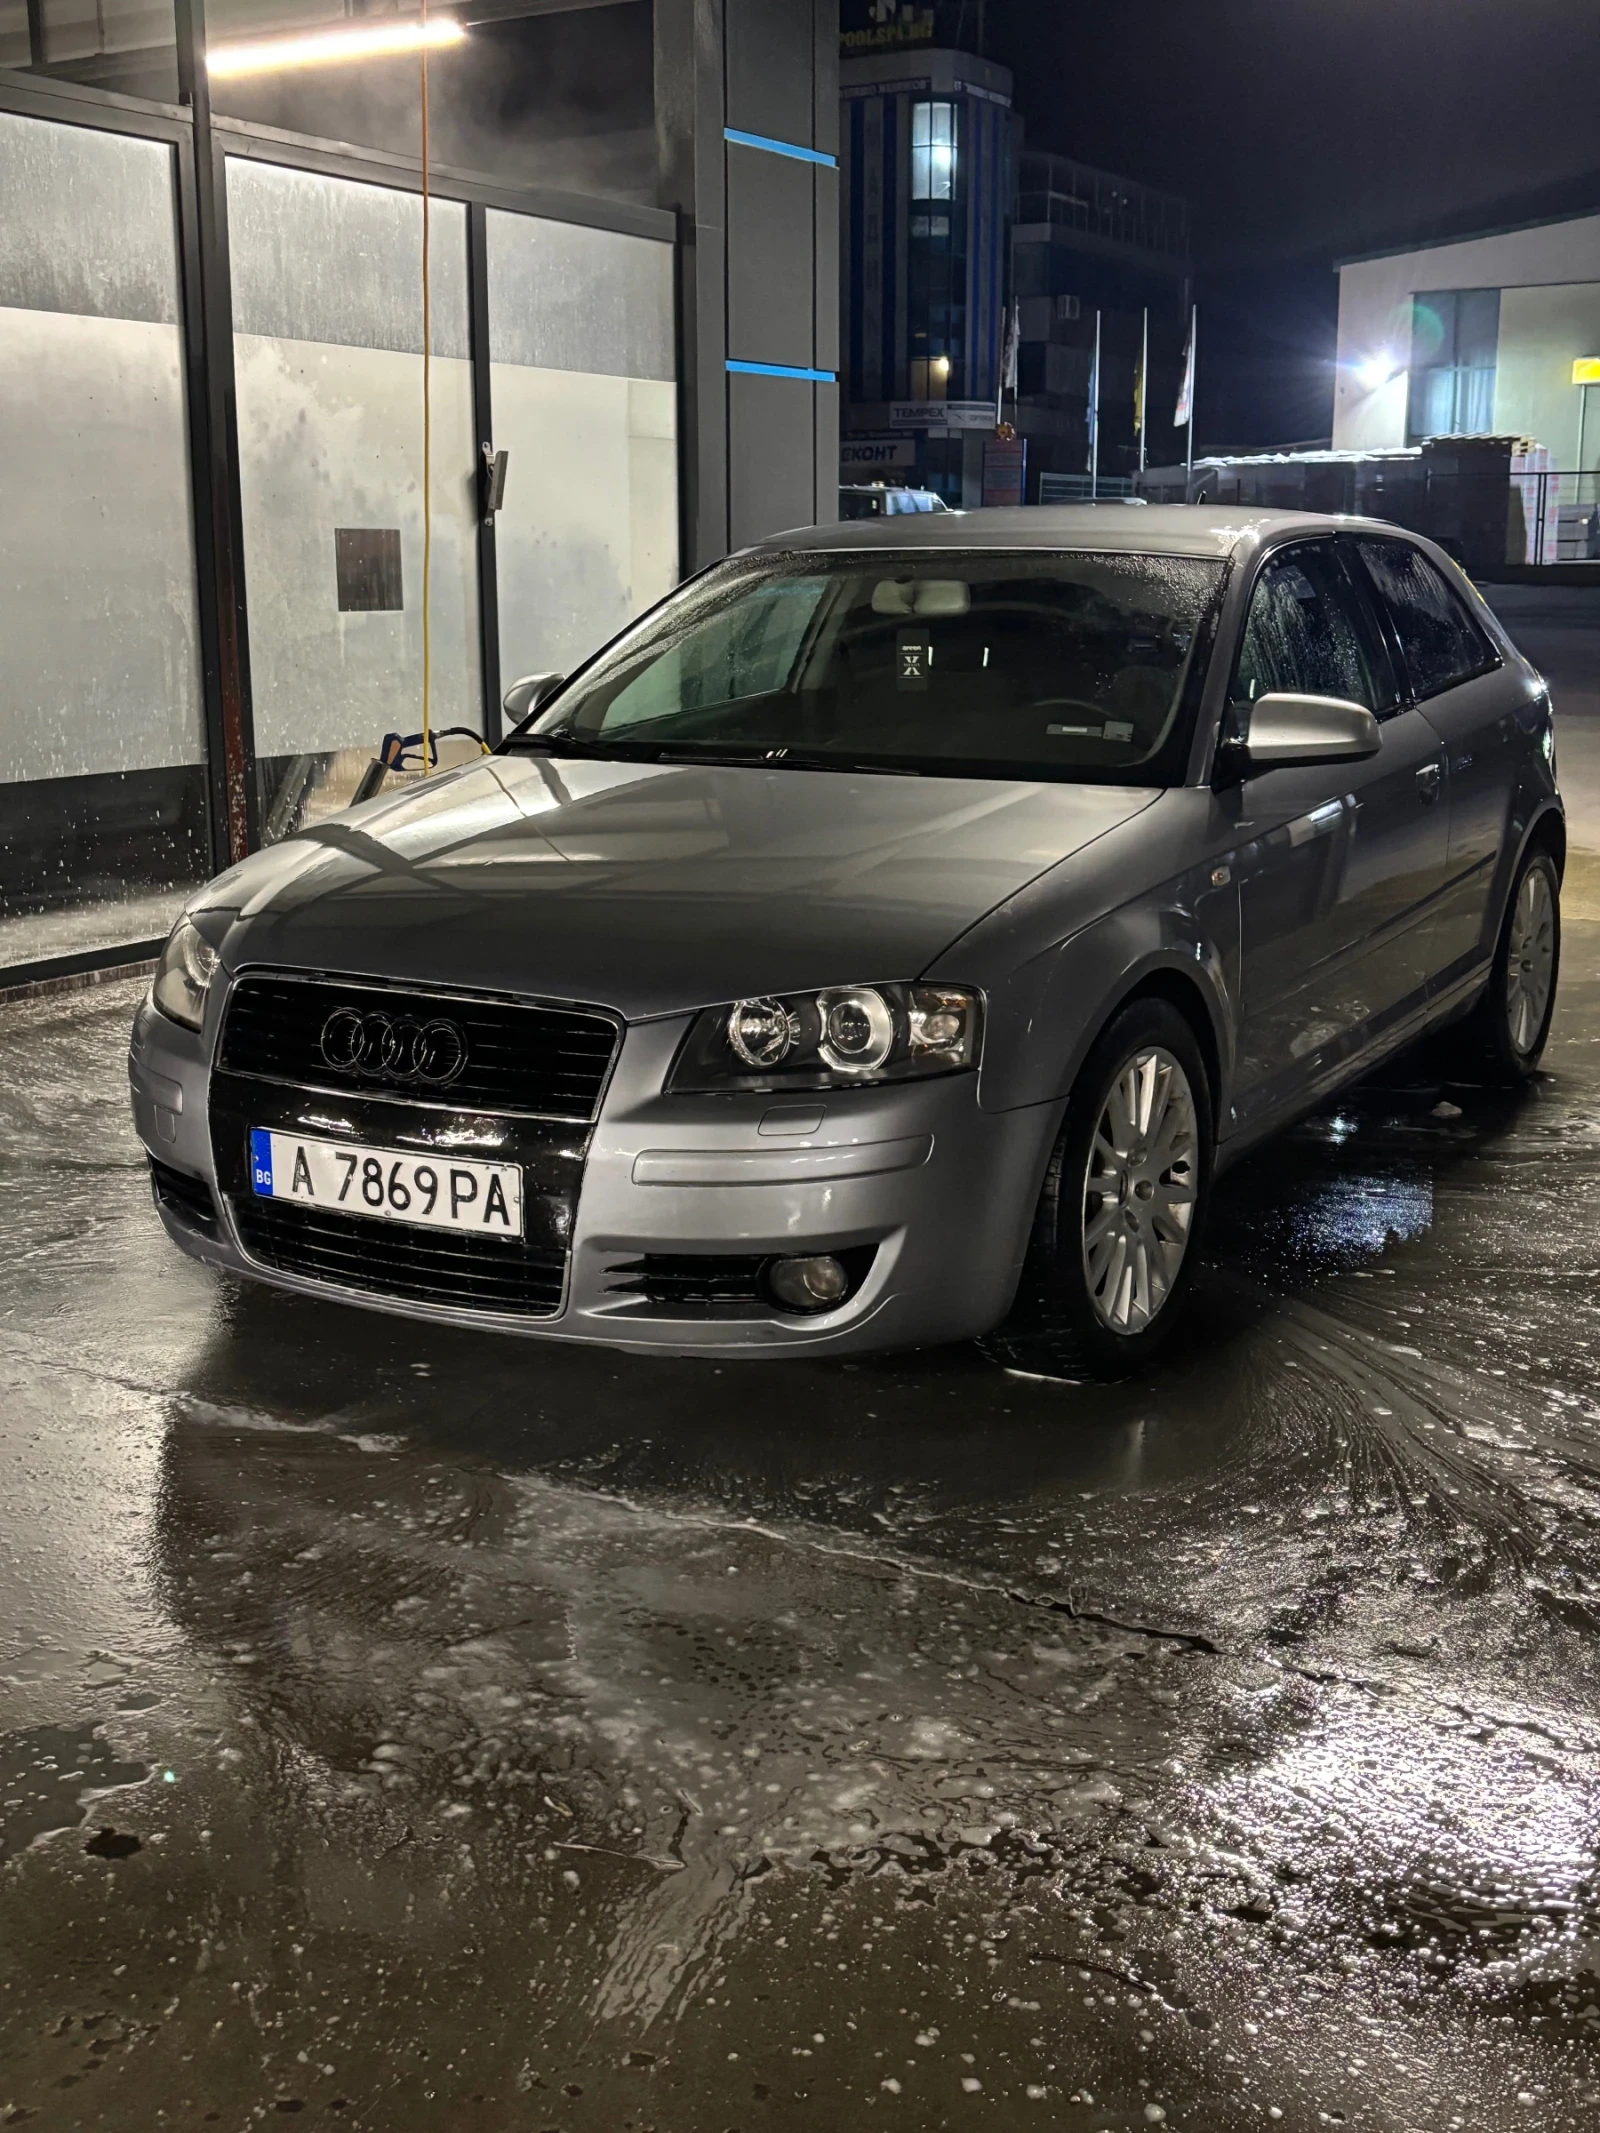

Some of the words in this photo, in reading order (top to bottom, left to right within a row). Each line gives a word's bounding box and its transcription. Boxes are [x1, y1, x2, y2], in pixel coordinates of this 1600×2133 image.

[894, 407, 944, 418] TEMPEX
[256, 1168, 271, 1185] BG
[292, 1145, 315, 1196] A
